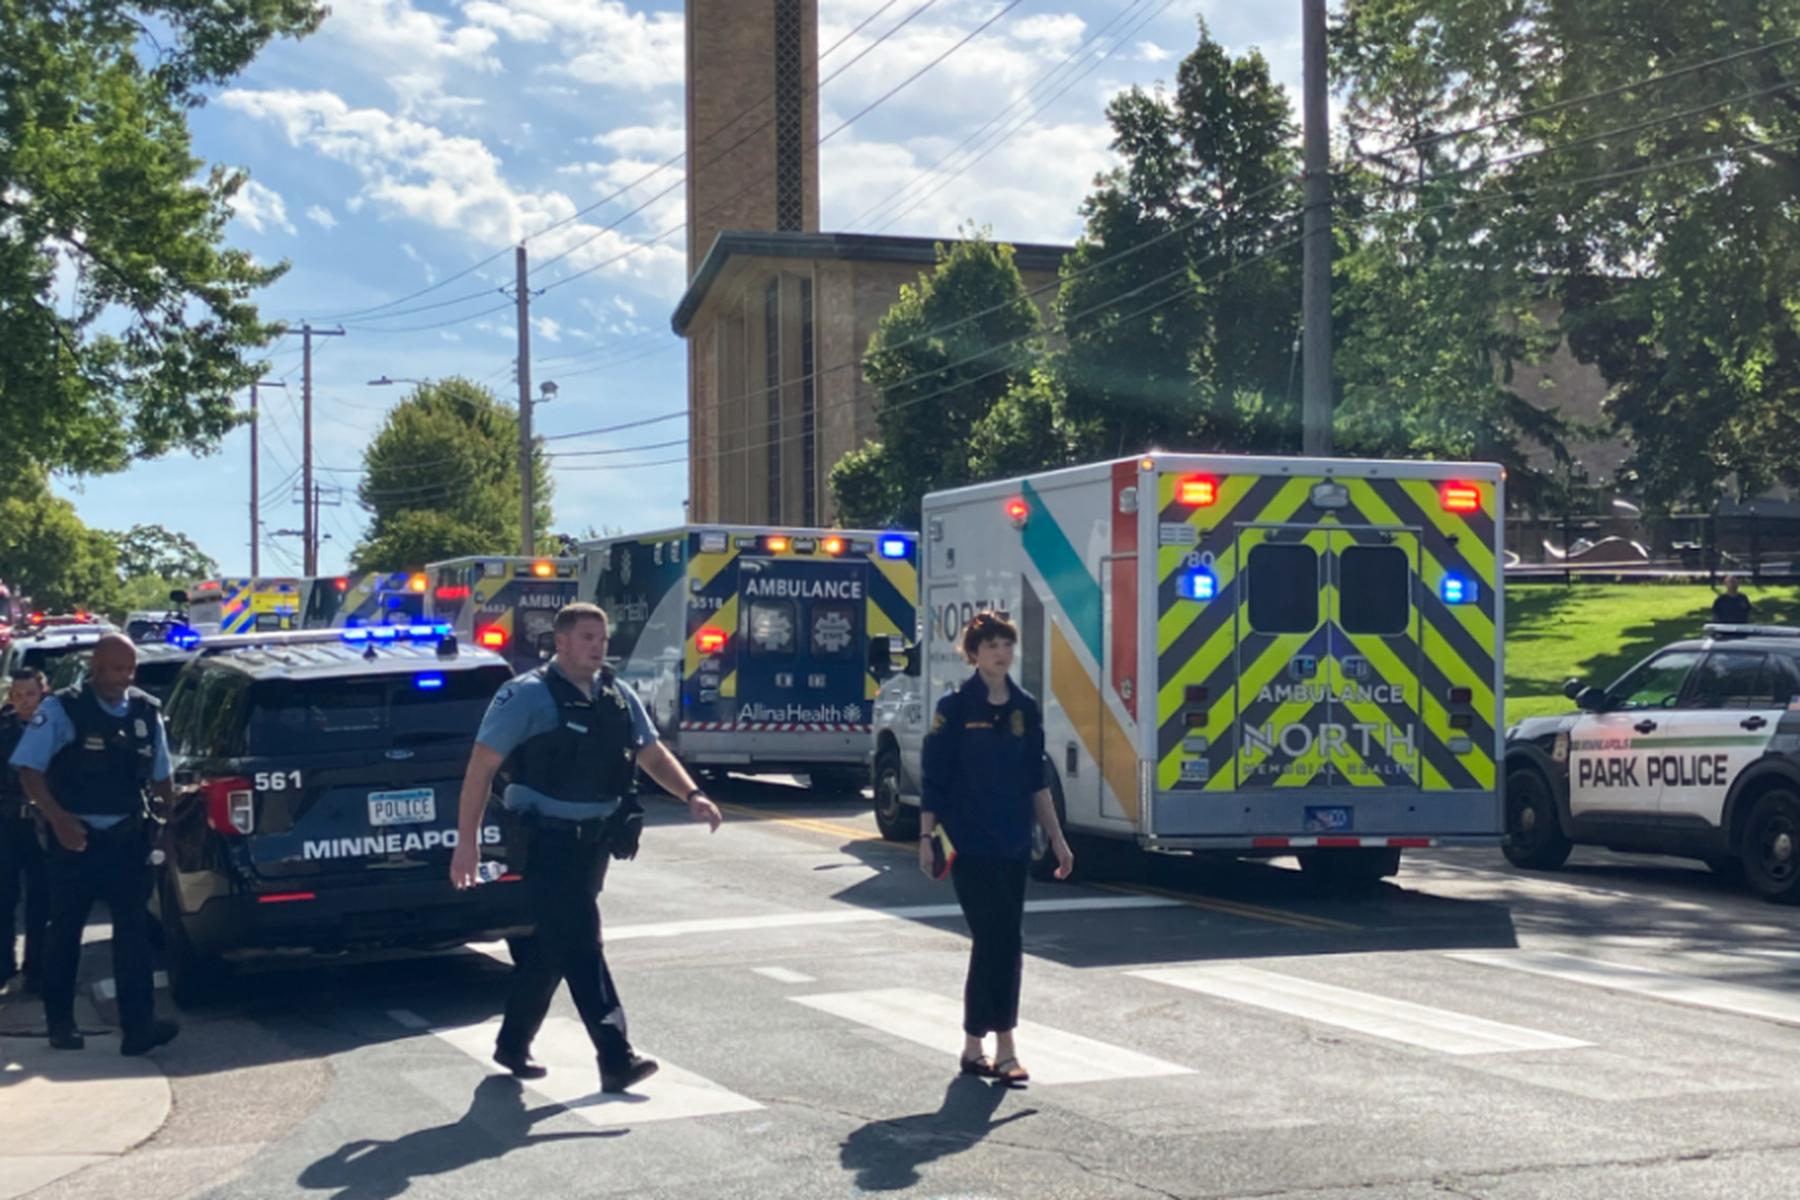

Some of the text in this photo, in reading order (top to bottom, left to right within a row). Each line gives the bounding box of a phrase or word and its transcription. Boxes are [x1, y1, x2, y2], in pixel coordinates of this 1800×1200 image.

[746, 578, 862, 599] AMBULANCE
[930, 598, 1006, 642] NOR
[1257, 684, 1404, 703] AMBULANCE
[1244, 722, 1415, 757] NORTH
[1243, 763, 1338, 775] MEMORIAL
[1578, 754, 1729, 788] PARK POLICE
[254, 770, 302, 791] 561
[375, 798, 430, 819] POLICE
[303, 825, 502, 860] MINNEAPOIS
